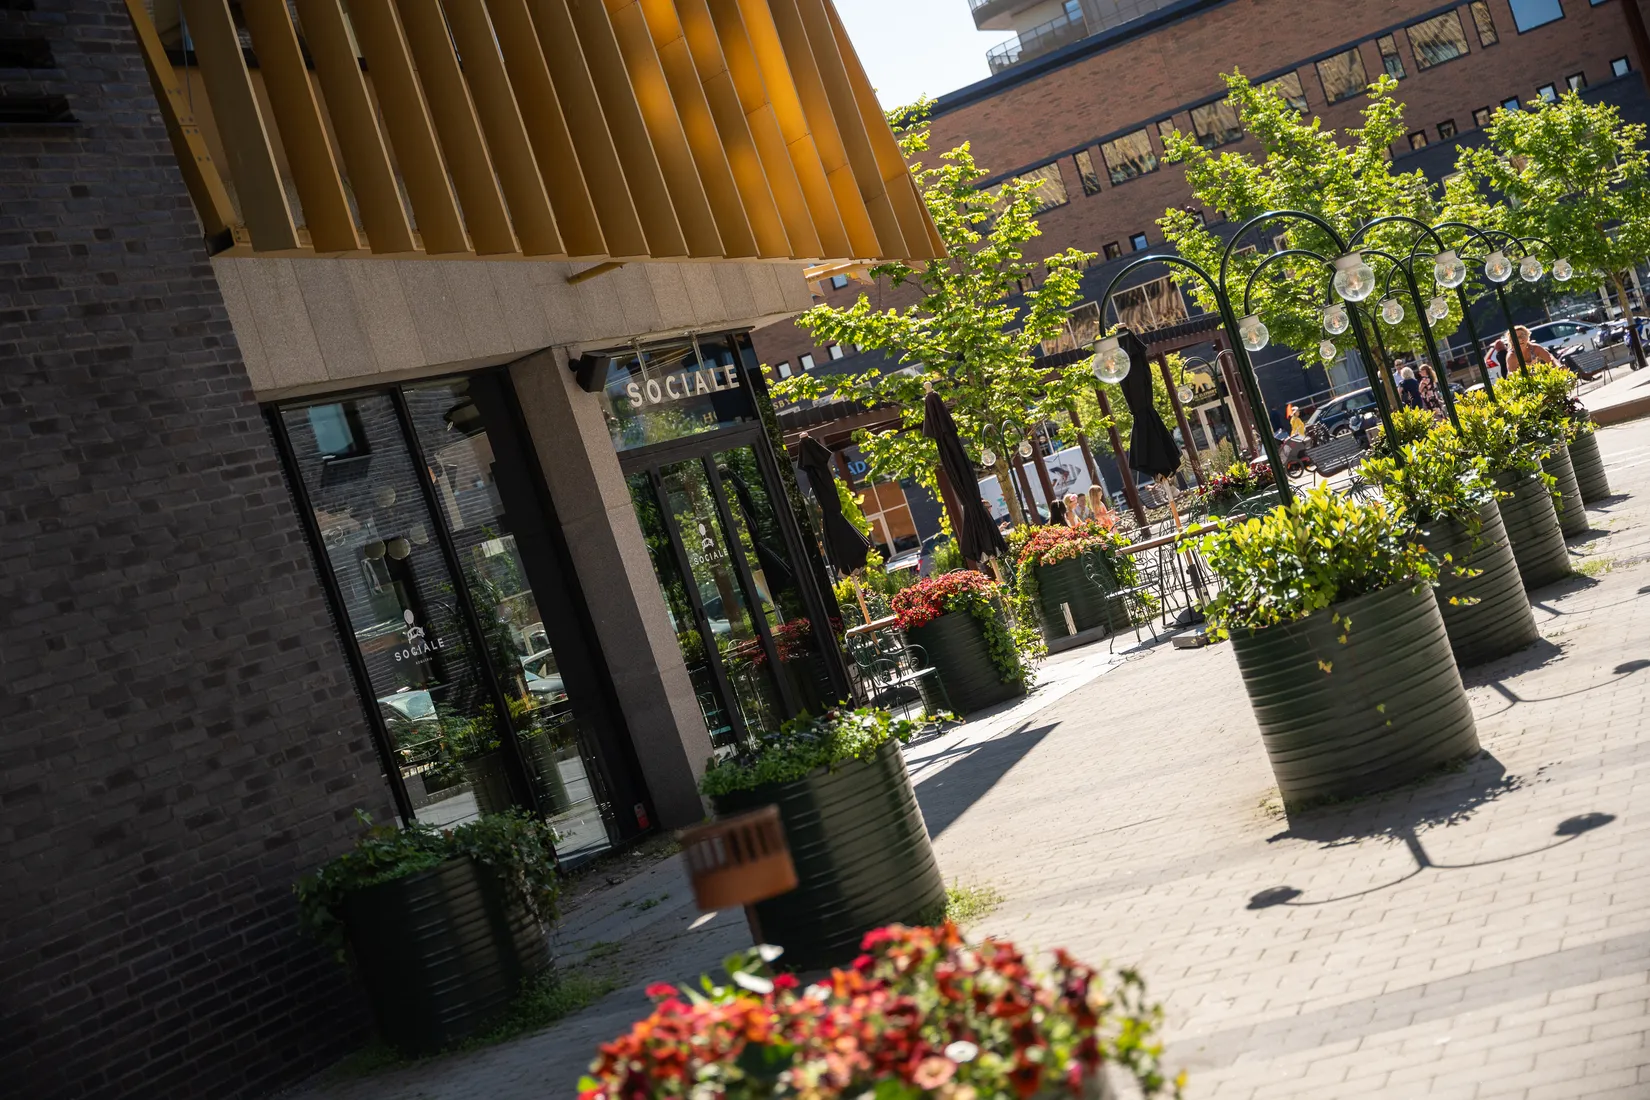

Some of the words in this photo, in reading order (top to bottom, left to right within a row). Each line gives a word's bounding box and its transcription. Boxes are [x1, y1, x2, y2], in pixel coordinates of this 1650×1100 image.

[626, 364, 740, 408] SOCIALE
[694, 547, 728, 566] SOCIALE
[394, 637, 445, 662] SOCIALE
